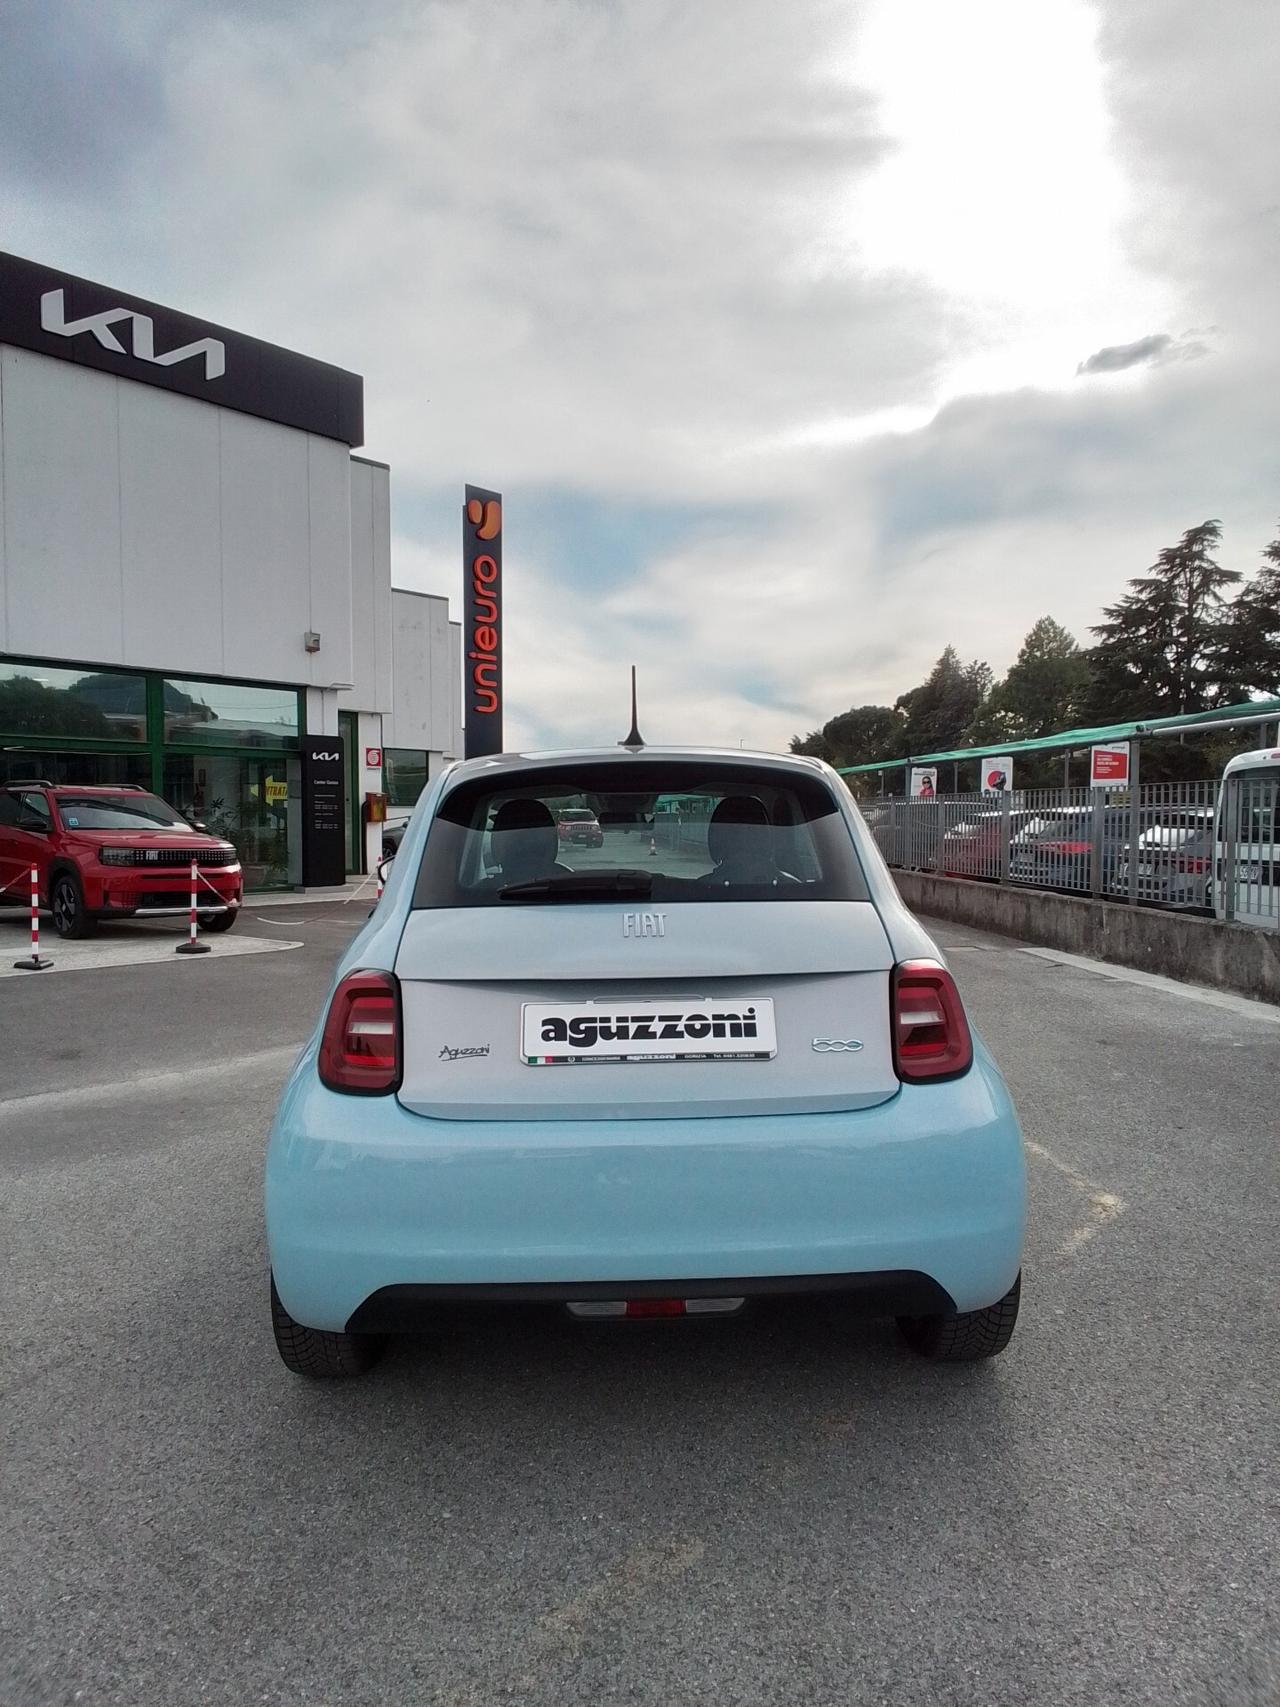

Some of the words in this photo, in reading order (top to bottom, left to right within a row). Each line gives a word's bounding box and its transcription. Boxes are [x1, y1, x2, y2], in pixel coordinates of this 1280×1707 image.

[469, 554, 499, 713] unieuro
[623, 912, 668, 938] FIAT
[540, 1007, 758, 1048] aguzzoni
[812, 1037, 864, 1053] 500
